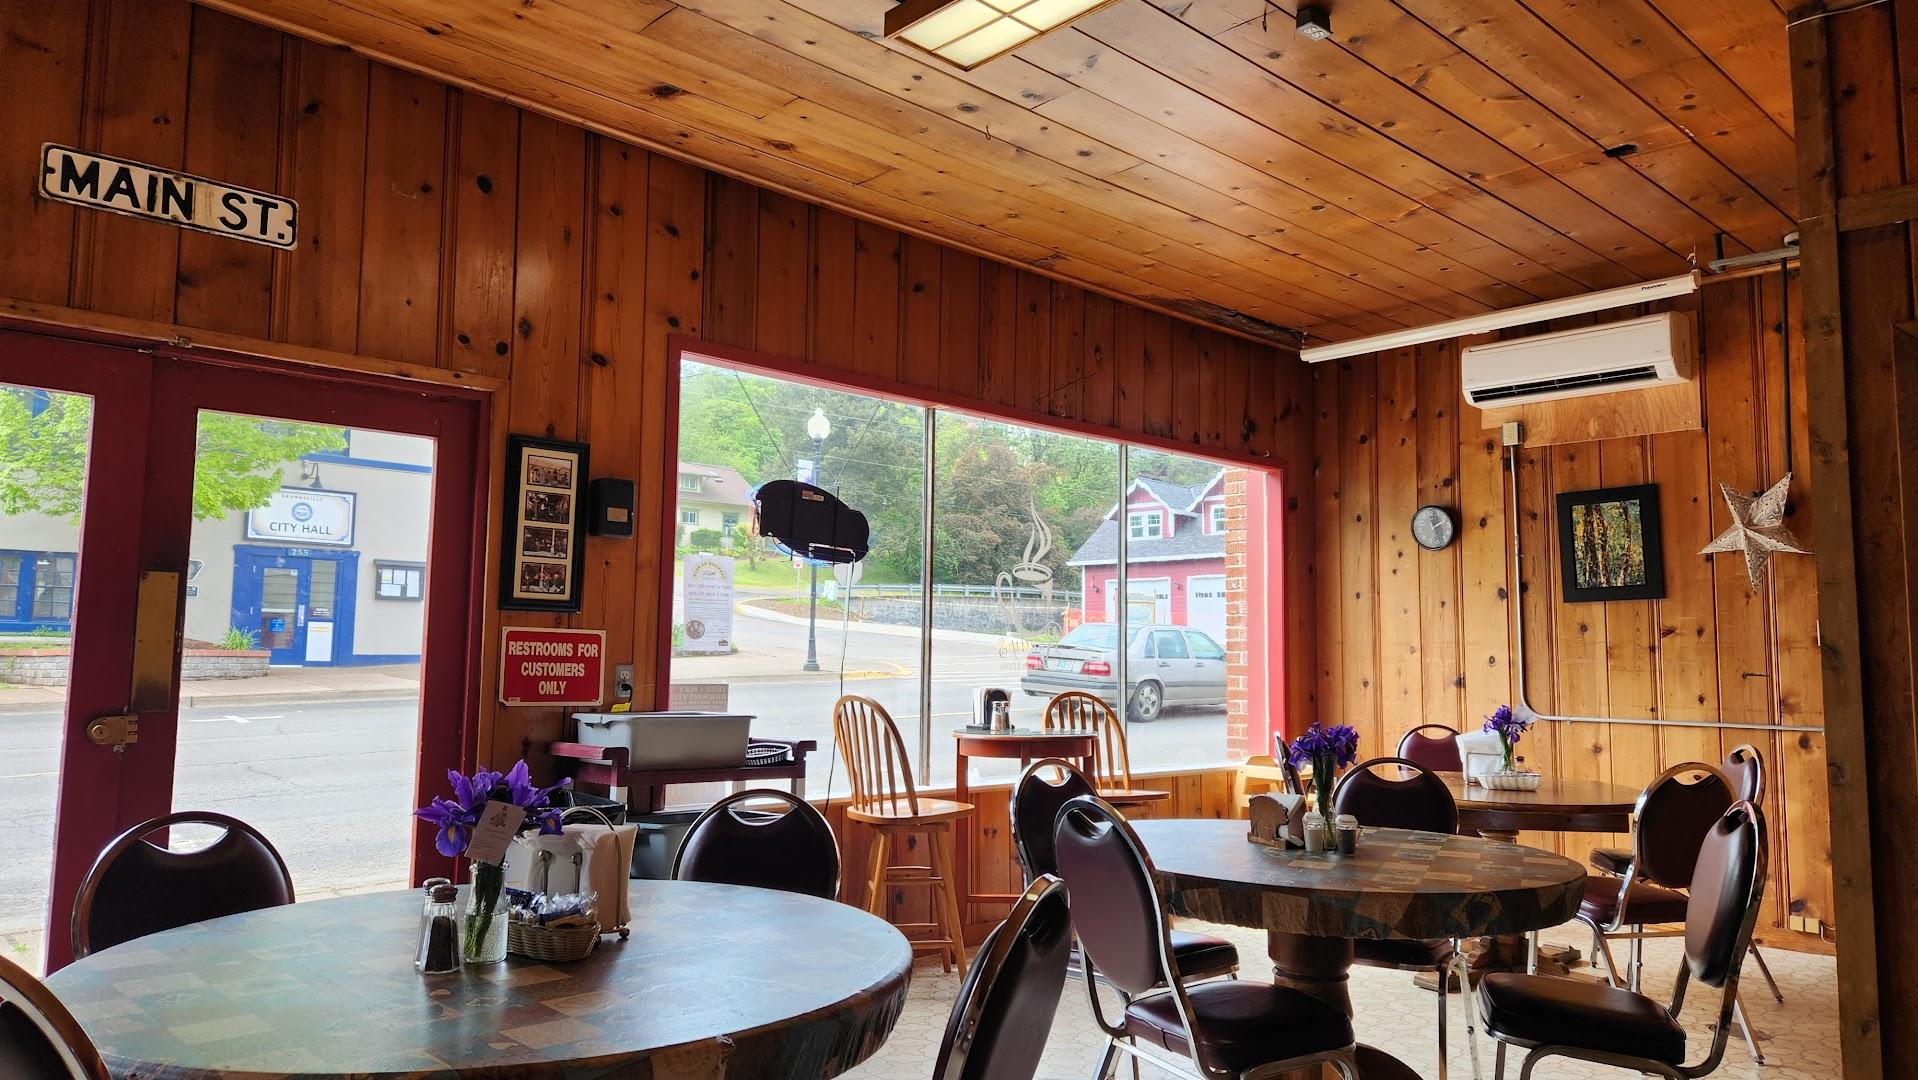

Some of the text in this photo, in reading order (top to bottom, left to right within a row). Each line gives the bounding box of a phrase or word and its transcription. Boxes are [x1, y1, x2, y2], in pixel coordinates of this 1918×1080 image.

[60, 154, 285, 240] MAIN ST.
[269, 521, 332, 535] CITY HALL
[291, 548, 309, 556] 255
[508, 641, 598, 657] RESTROOMS FOR
[520, 662, 585, 677] CUSTOMERS
[538, 680, 567, 695] ONLY
